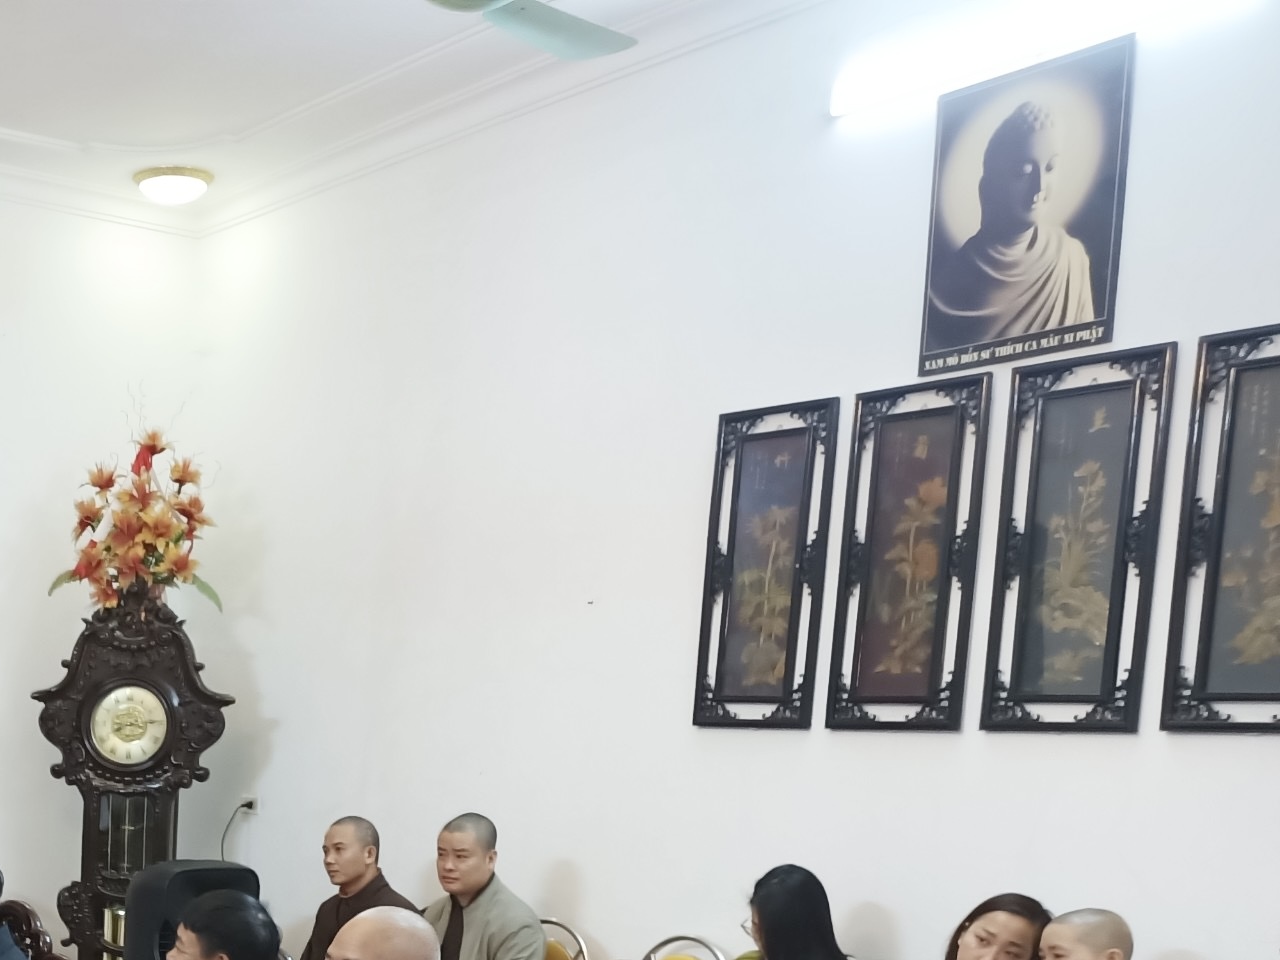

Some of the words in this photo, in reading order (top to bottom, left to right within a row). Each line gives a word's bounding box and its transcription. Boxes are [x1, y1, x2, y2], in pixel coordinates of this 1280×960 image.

[995, 341, 1023, 357] THÍCH
[1024, 340, 1037, 351] CA
[1076, 326, 1104, 343] PHẬT
